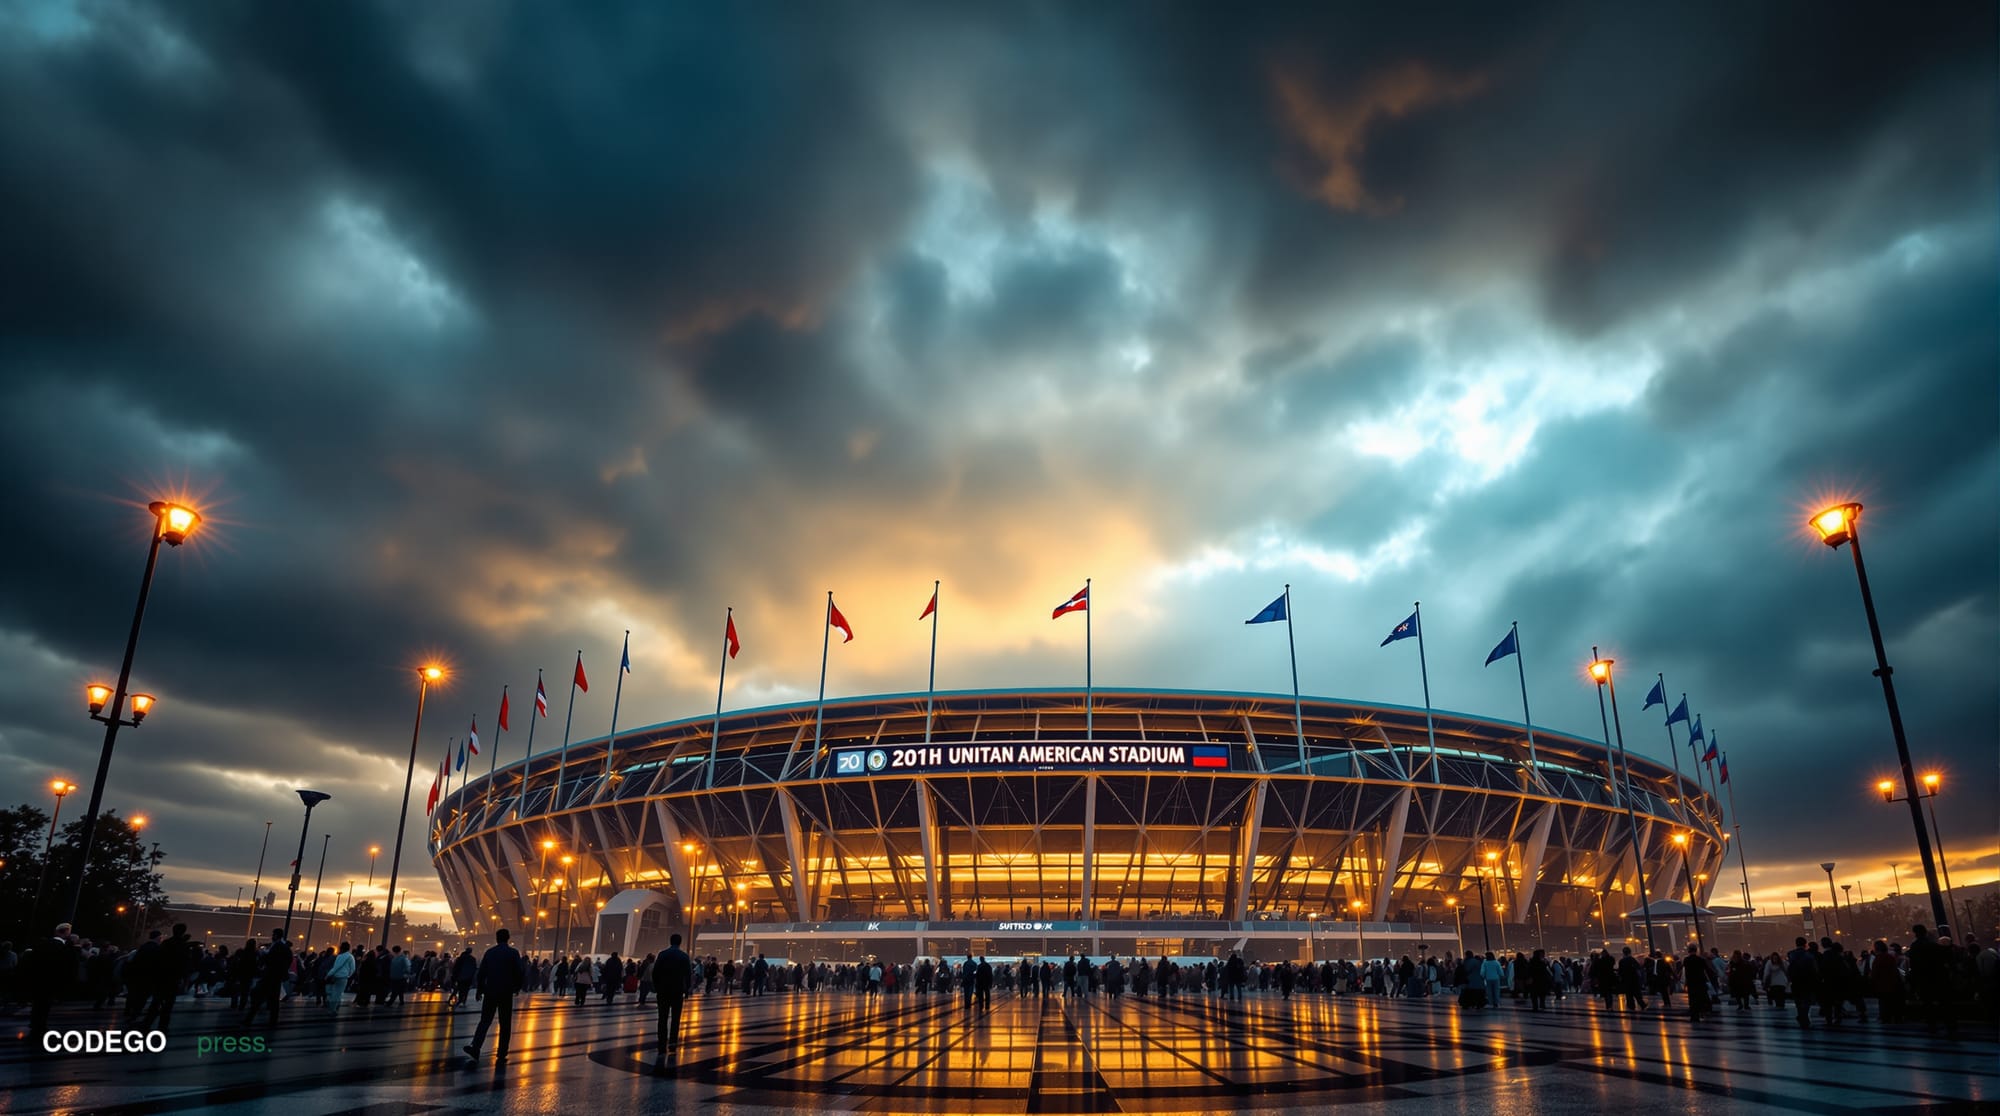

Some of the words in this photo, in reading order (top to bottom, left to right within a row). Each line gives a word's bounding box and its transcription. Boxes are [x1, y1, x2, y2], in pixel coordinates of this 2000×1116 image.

[891, 748, 942, 767] 201H
[948, 746, 1014, 765] UNITAN
[1017, 746, 1104, 763] AMERICAN
[1108, 746, 1185, 764] STADIUM
